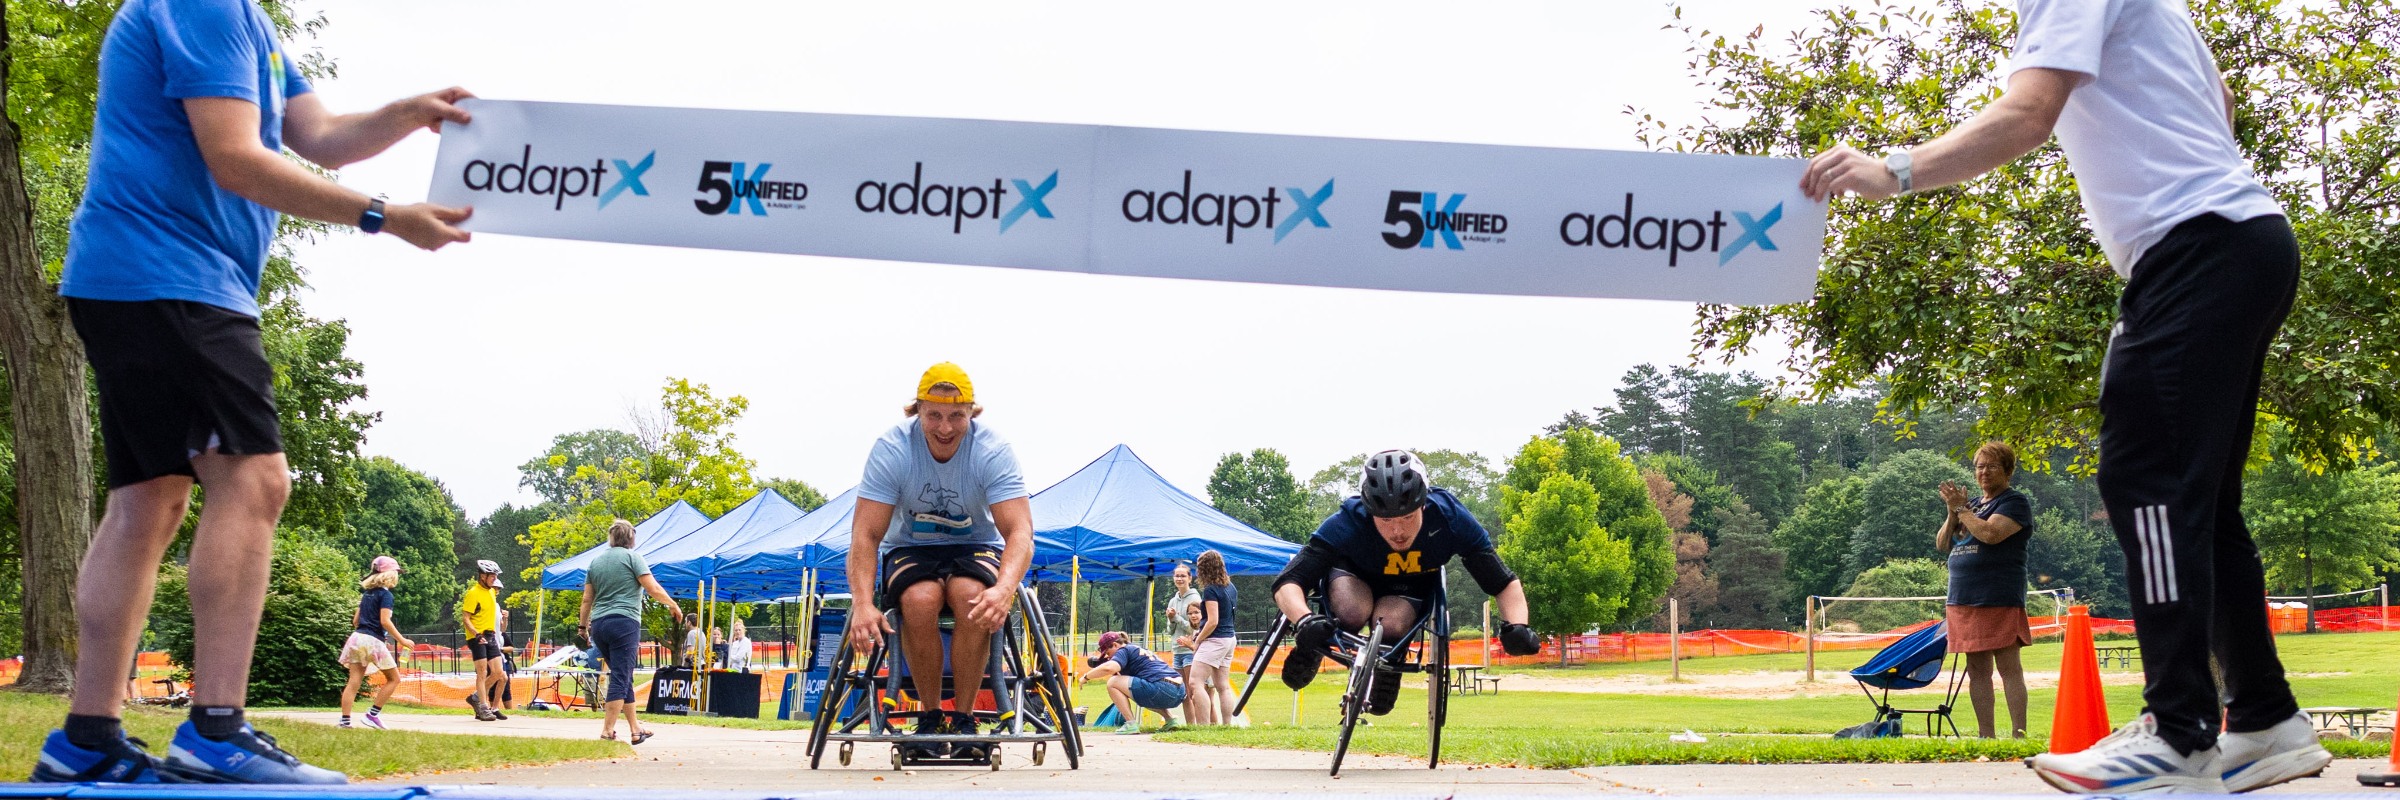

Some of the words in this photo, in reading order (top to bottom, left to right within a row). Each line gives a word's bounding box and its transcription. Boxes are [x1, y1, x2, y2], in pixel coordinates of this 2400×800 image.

[463, 143, 656, 211] adaptX
[694, 160, 772, 216] 5K
[734, 179, 808, 201] UNIFIED
[855, 161, 1059, 236] adaptX
[1122, 169, 1335, 246] adaptX
[1381, 190, 1467, 250] 5K
[1425, 211, 1508, 234] UNIFIED
[1560, 192, 1784, 268] adaptX
[1384, 551, 1421, 575] M
